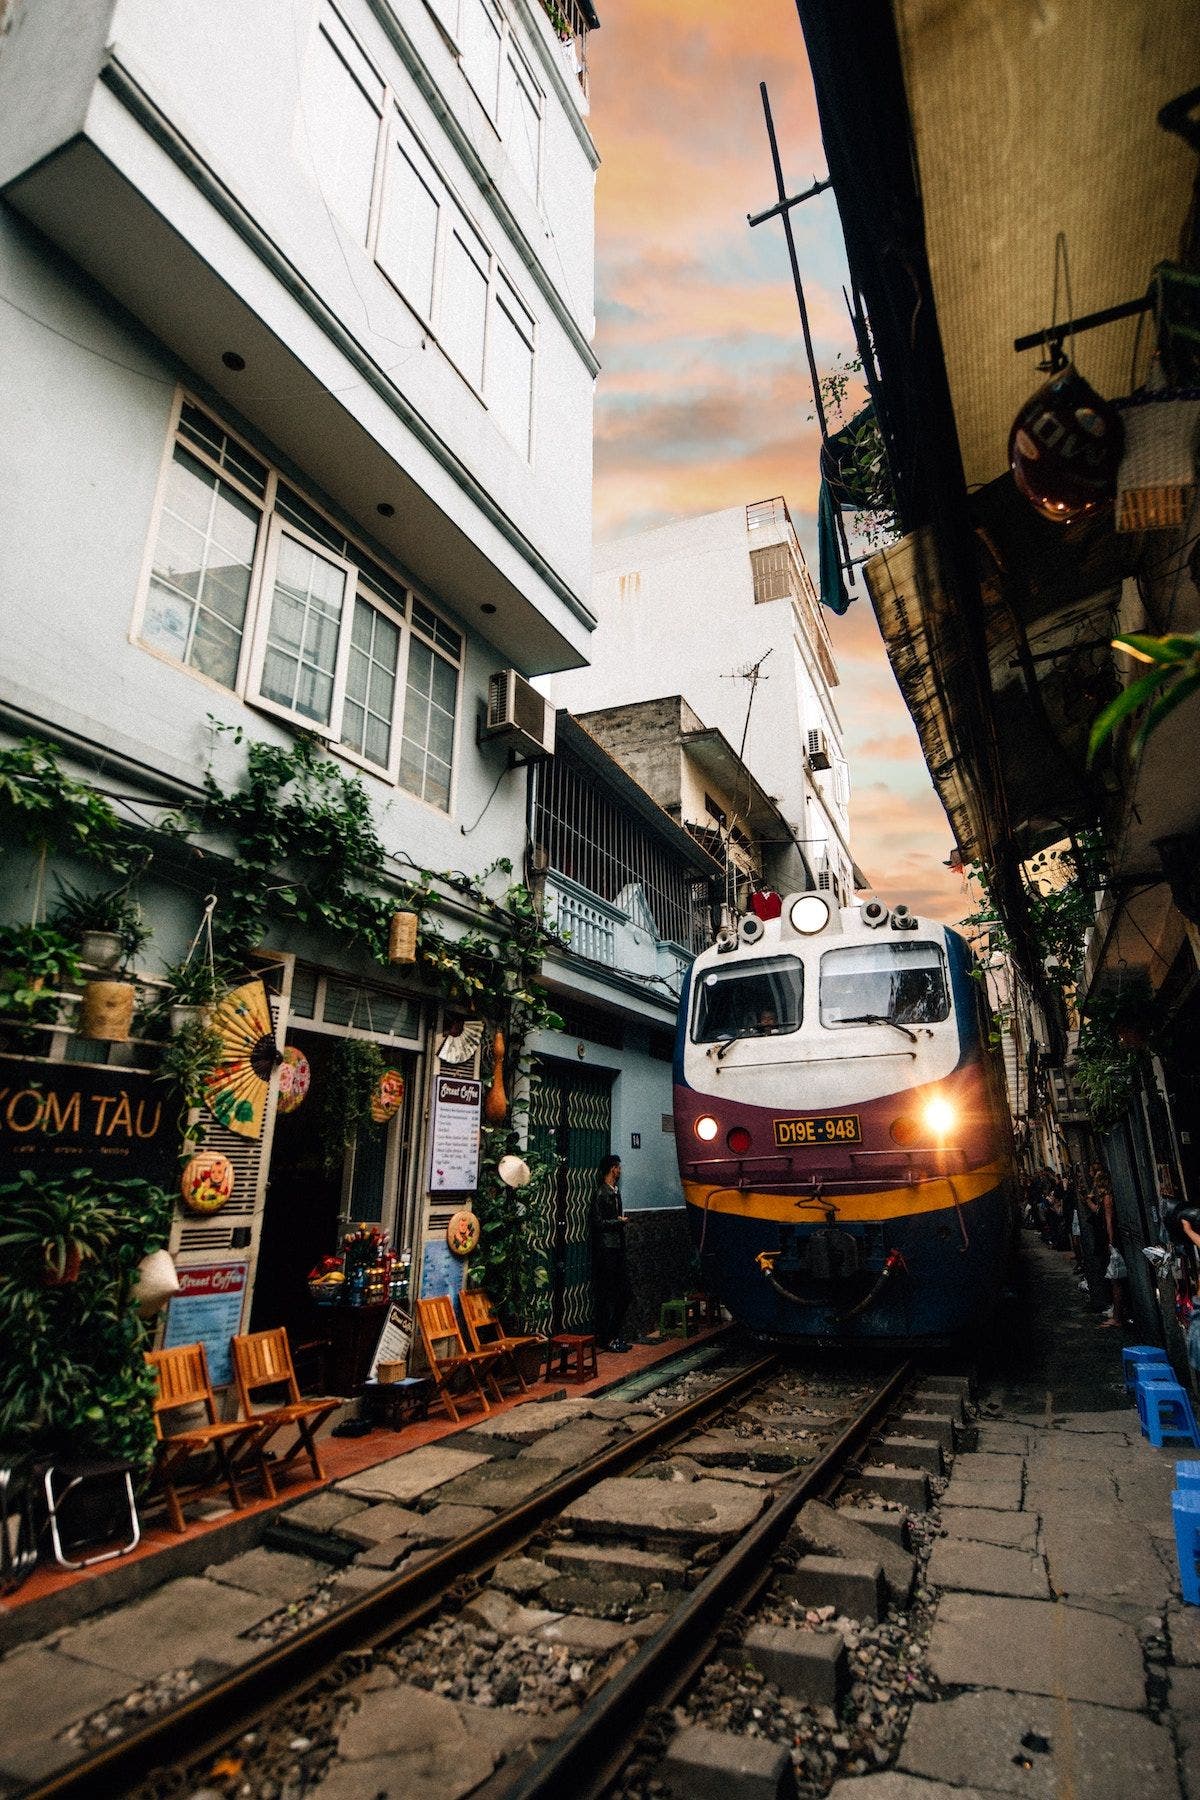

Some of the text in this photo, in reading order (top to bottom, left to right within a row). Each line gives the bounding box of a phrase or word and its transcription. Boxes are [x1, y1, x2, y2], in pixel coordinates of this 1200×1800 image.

[440, 1083, 479, 1102] Street Coffee
[90, 1090, 162, 1138] TÀU
[179, 1271, 242, 1291] Street Coffee
